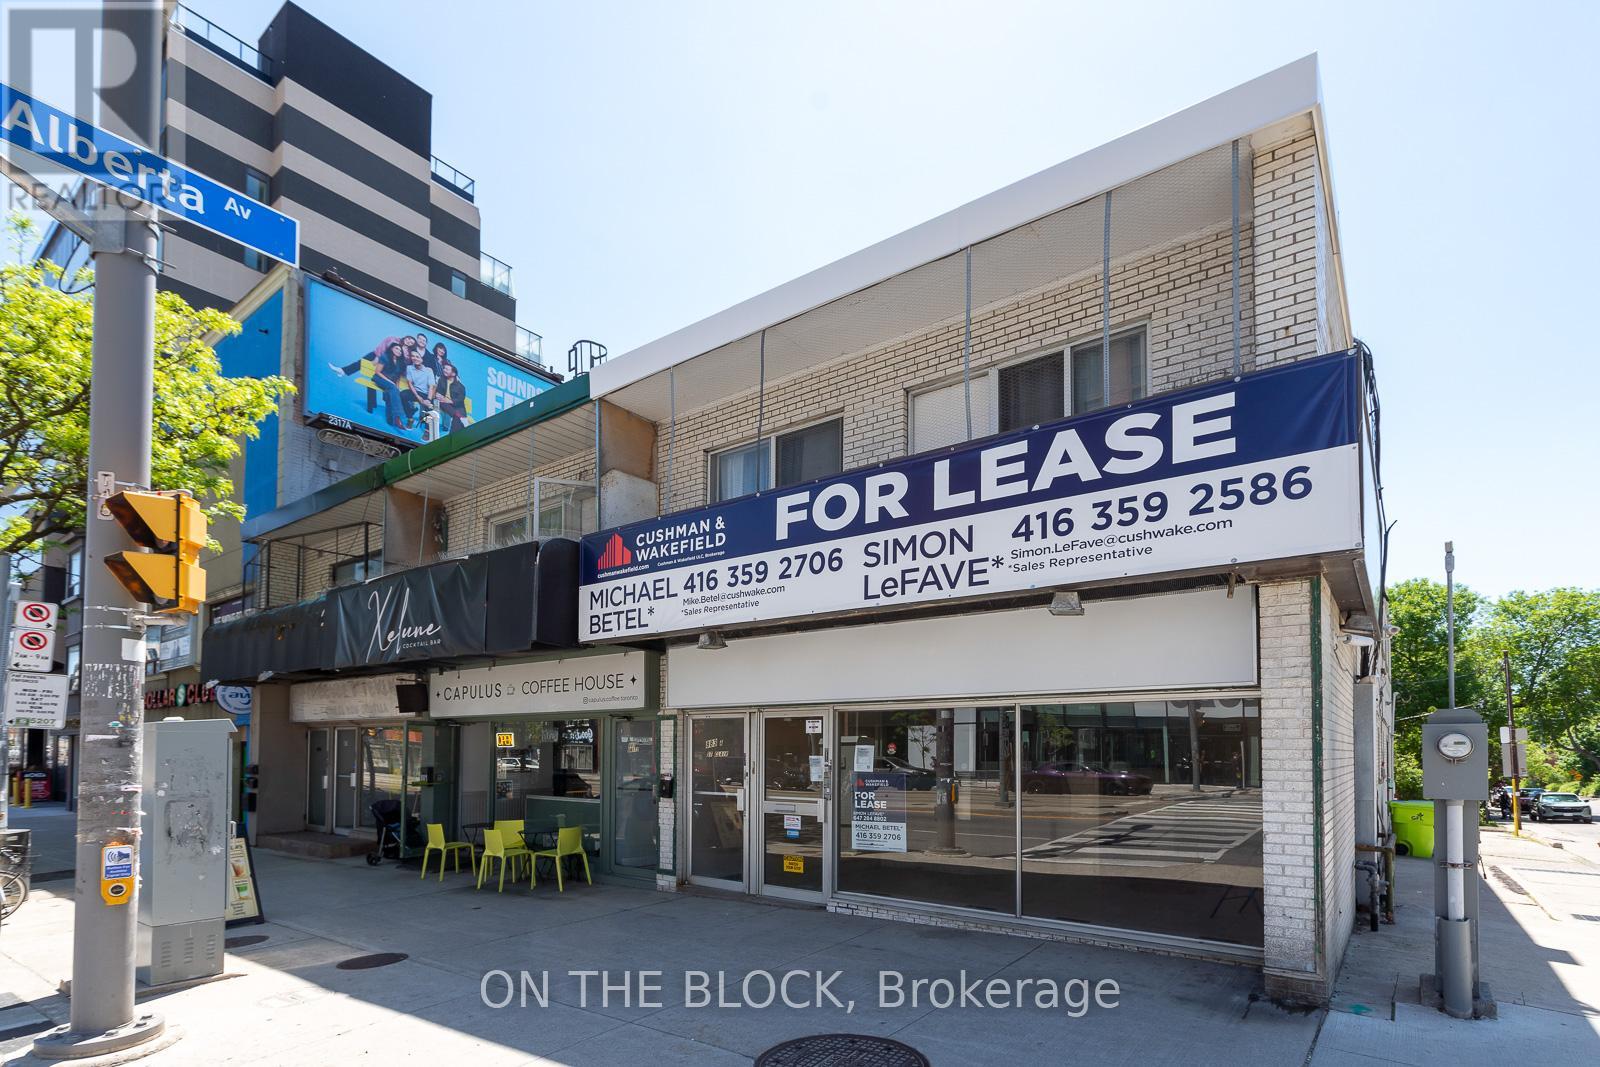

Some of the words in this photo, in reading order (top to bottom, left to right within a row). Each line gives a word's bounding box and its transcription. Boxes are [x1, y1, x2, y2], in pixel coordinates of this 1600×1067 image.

[1, 99, 205, 214] Alberta
[224, 196, 252, 220] Av
[328, 416, 352, 430] 2317A
[775, 472, 910, 541] FOR
[932, 392, 1237, 511] LEASE
[1011, 507, 1075, 543] 416
[1090, 491, 1169, 531] 359
[1189, 465, 1313, 516] 2586
[636, 519, 710, 546] CUSHMAN
[715, 515, 726, 530] &
[1010, 518, 1234, 560] Simon.LeFave@cushwake.com
[635, 532, 726, 562] WAKEFIELD
[863, 525, 974, 568] SIMON
[1049, 546, 1153, 568] Representative
[683, 569, 718, 594] 416
[727, 560, 769, 587] 359
[778, 547, 844, 580] 2706
[589, 576, 678, 611] MICHAEL
[683, 584, 785, 606] Mike.Betel@cushwake.com
[709, 600, 760, 614] Representative
[402, 640, 429, 649] COCKTAIL
[430, 638, 441, 646] BAR
[443, 682, 502, 701] CAPULUS
[521, 677, 570, 695] COFFEE
[574, 673, 625, 692] HOUSE
[30, 717, 56, 725] 5207
[498, 734, 513, 746] OPEN
[854, 791, 876, 800] FOR
[854, 800, 887, 809] LEASE
[868, 832, 882, 840] 359
[883, 833, 902, 841] 2706
